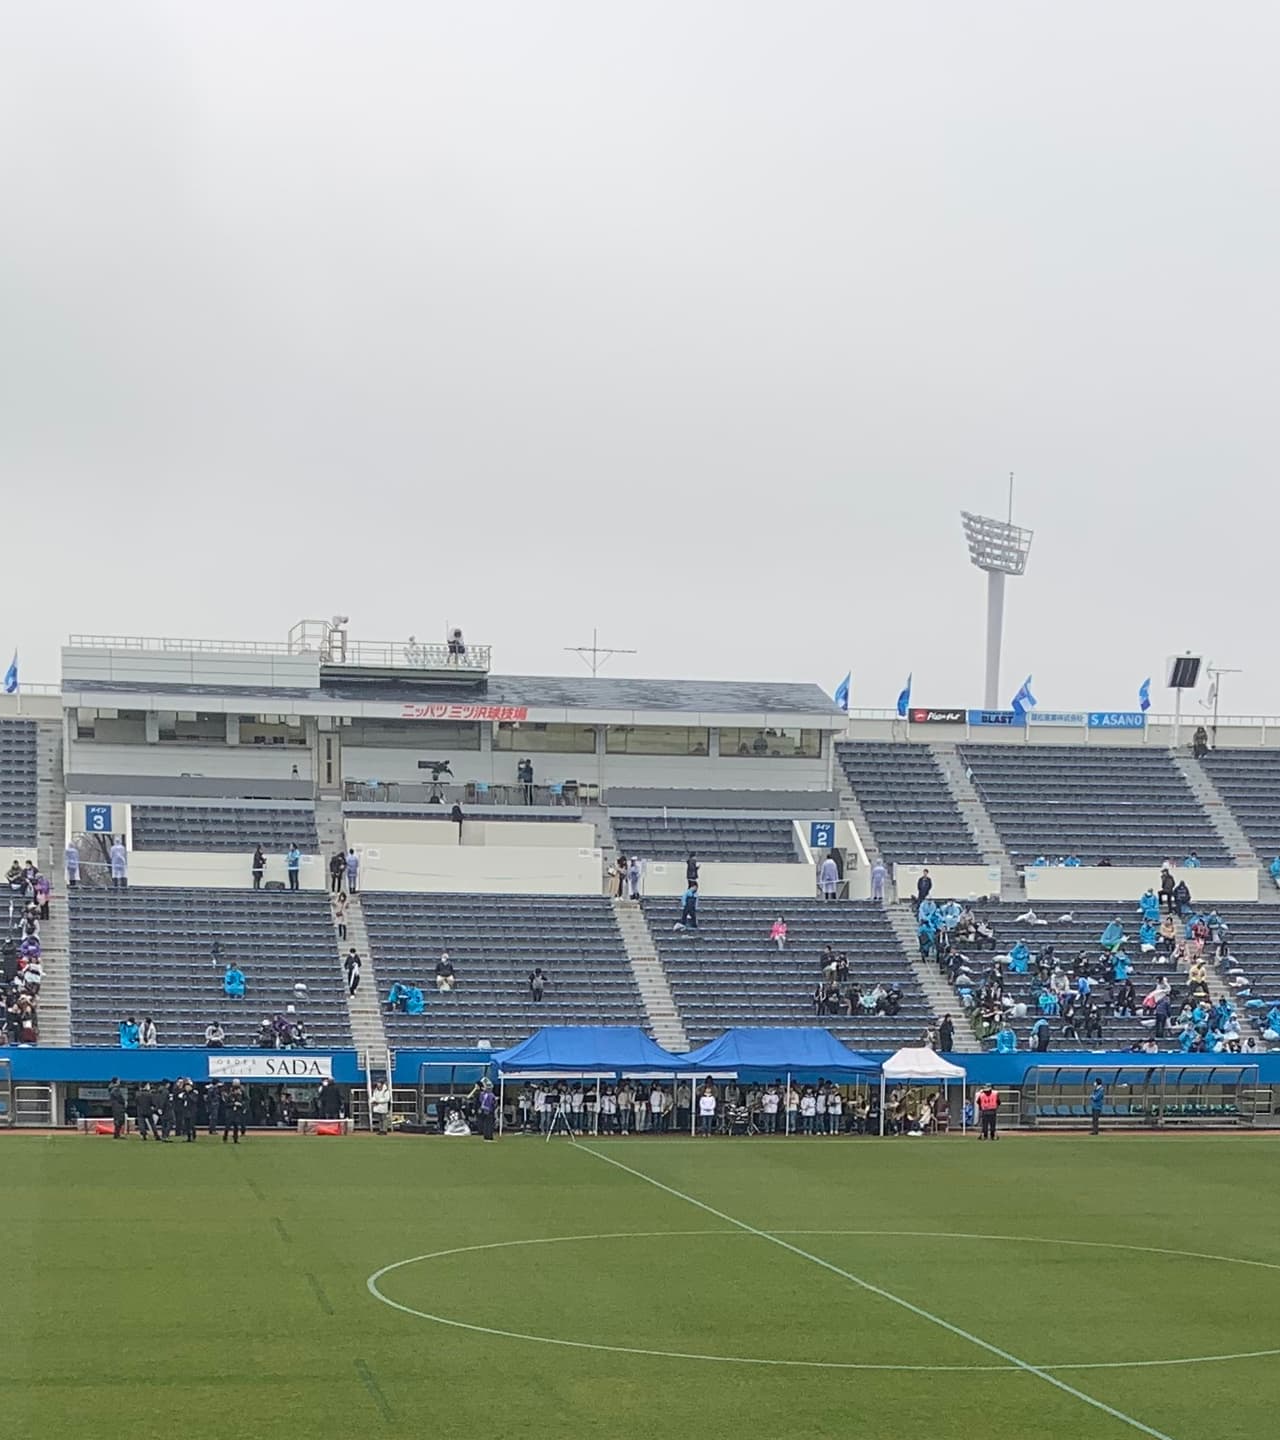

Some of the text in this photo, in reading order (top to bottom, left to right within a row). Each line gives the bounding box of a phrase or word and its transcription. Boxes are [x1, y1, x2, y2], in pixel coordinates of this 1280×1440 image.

[981, 715, 1014, 724] BLAST
[1091, 714, 1100, 726] S
[1102, 714, 1143, 726] ASANO
[93, 815, 104, 830] 3
[817, 831, 828, 846] 2
[266, 1059, 322, 1075] SADA
